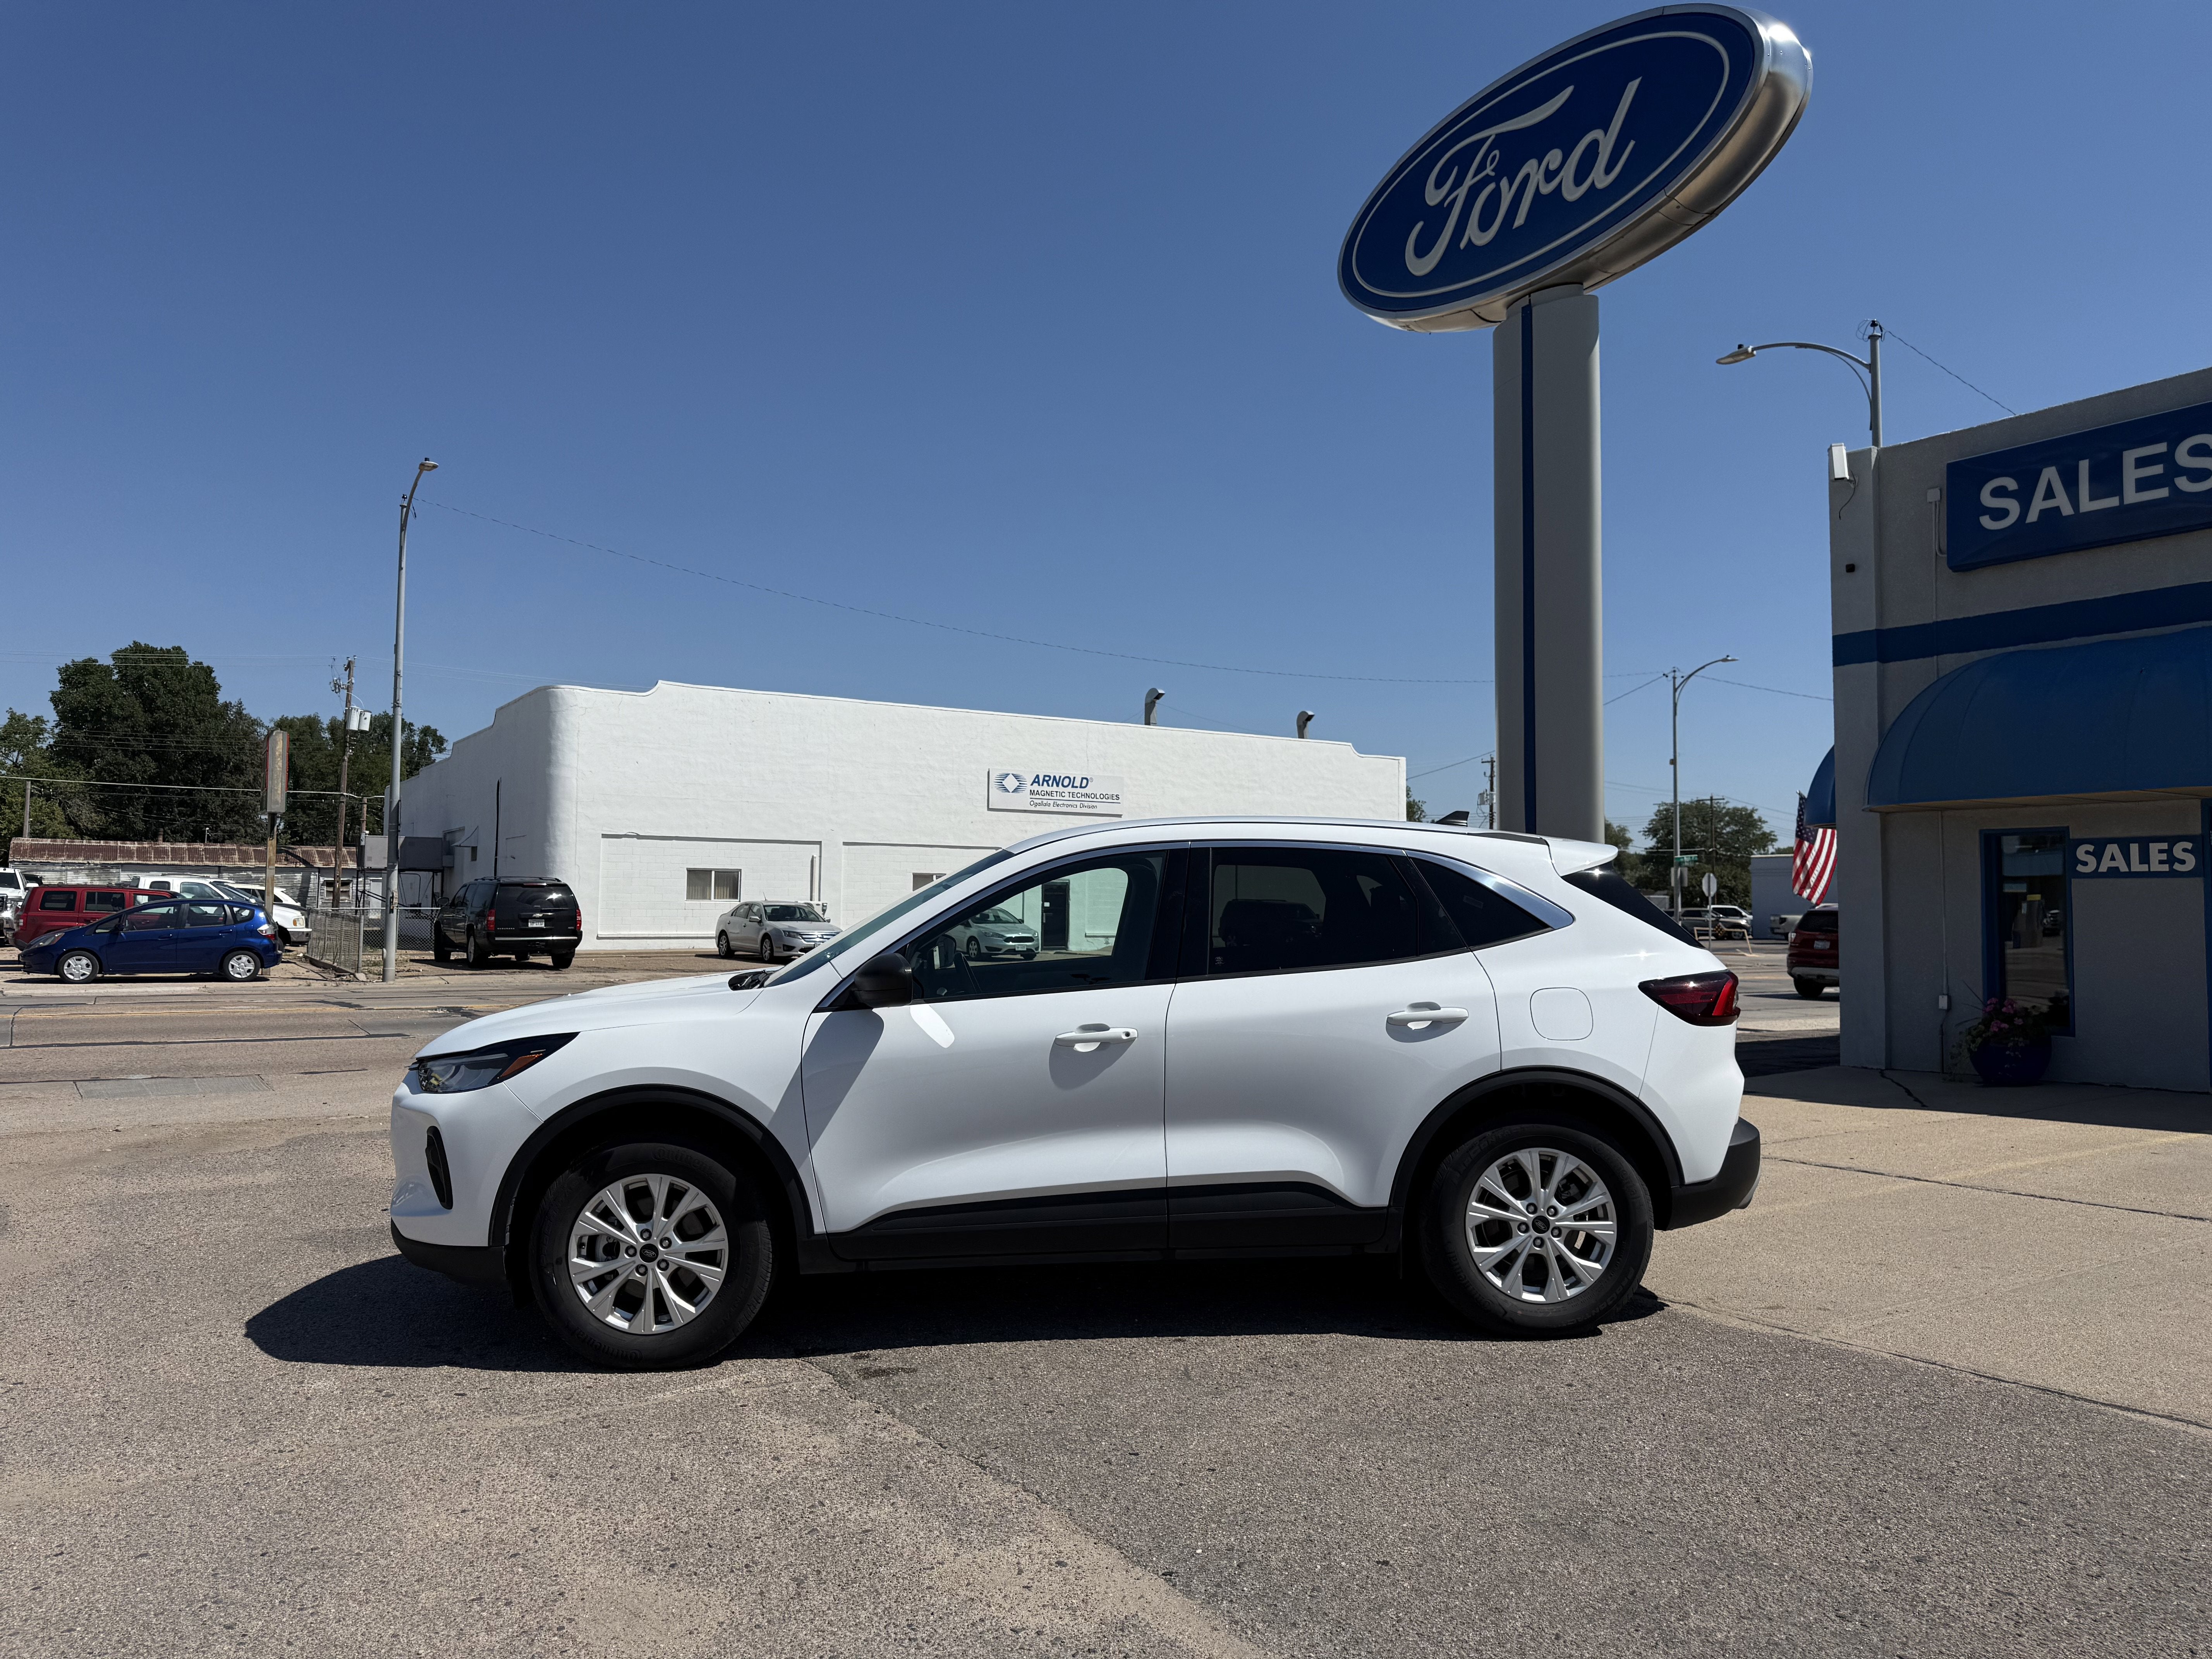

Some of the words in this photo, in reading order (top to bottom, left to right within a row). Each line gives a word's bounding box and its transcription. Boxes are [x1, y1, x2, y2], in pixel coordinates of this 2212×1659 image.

[1405, 76, 1642, 276] Ford
[1979, 433, 2212, 531] SALES
[1029, 789, 1065, 798] MAGNETIC
[1067, 791, 1120, 800] TECHNOLOGIES
[2076, 841, 2196, 873] SALES
